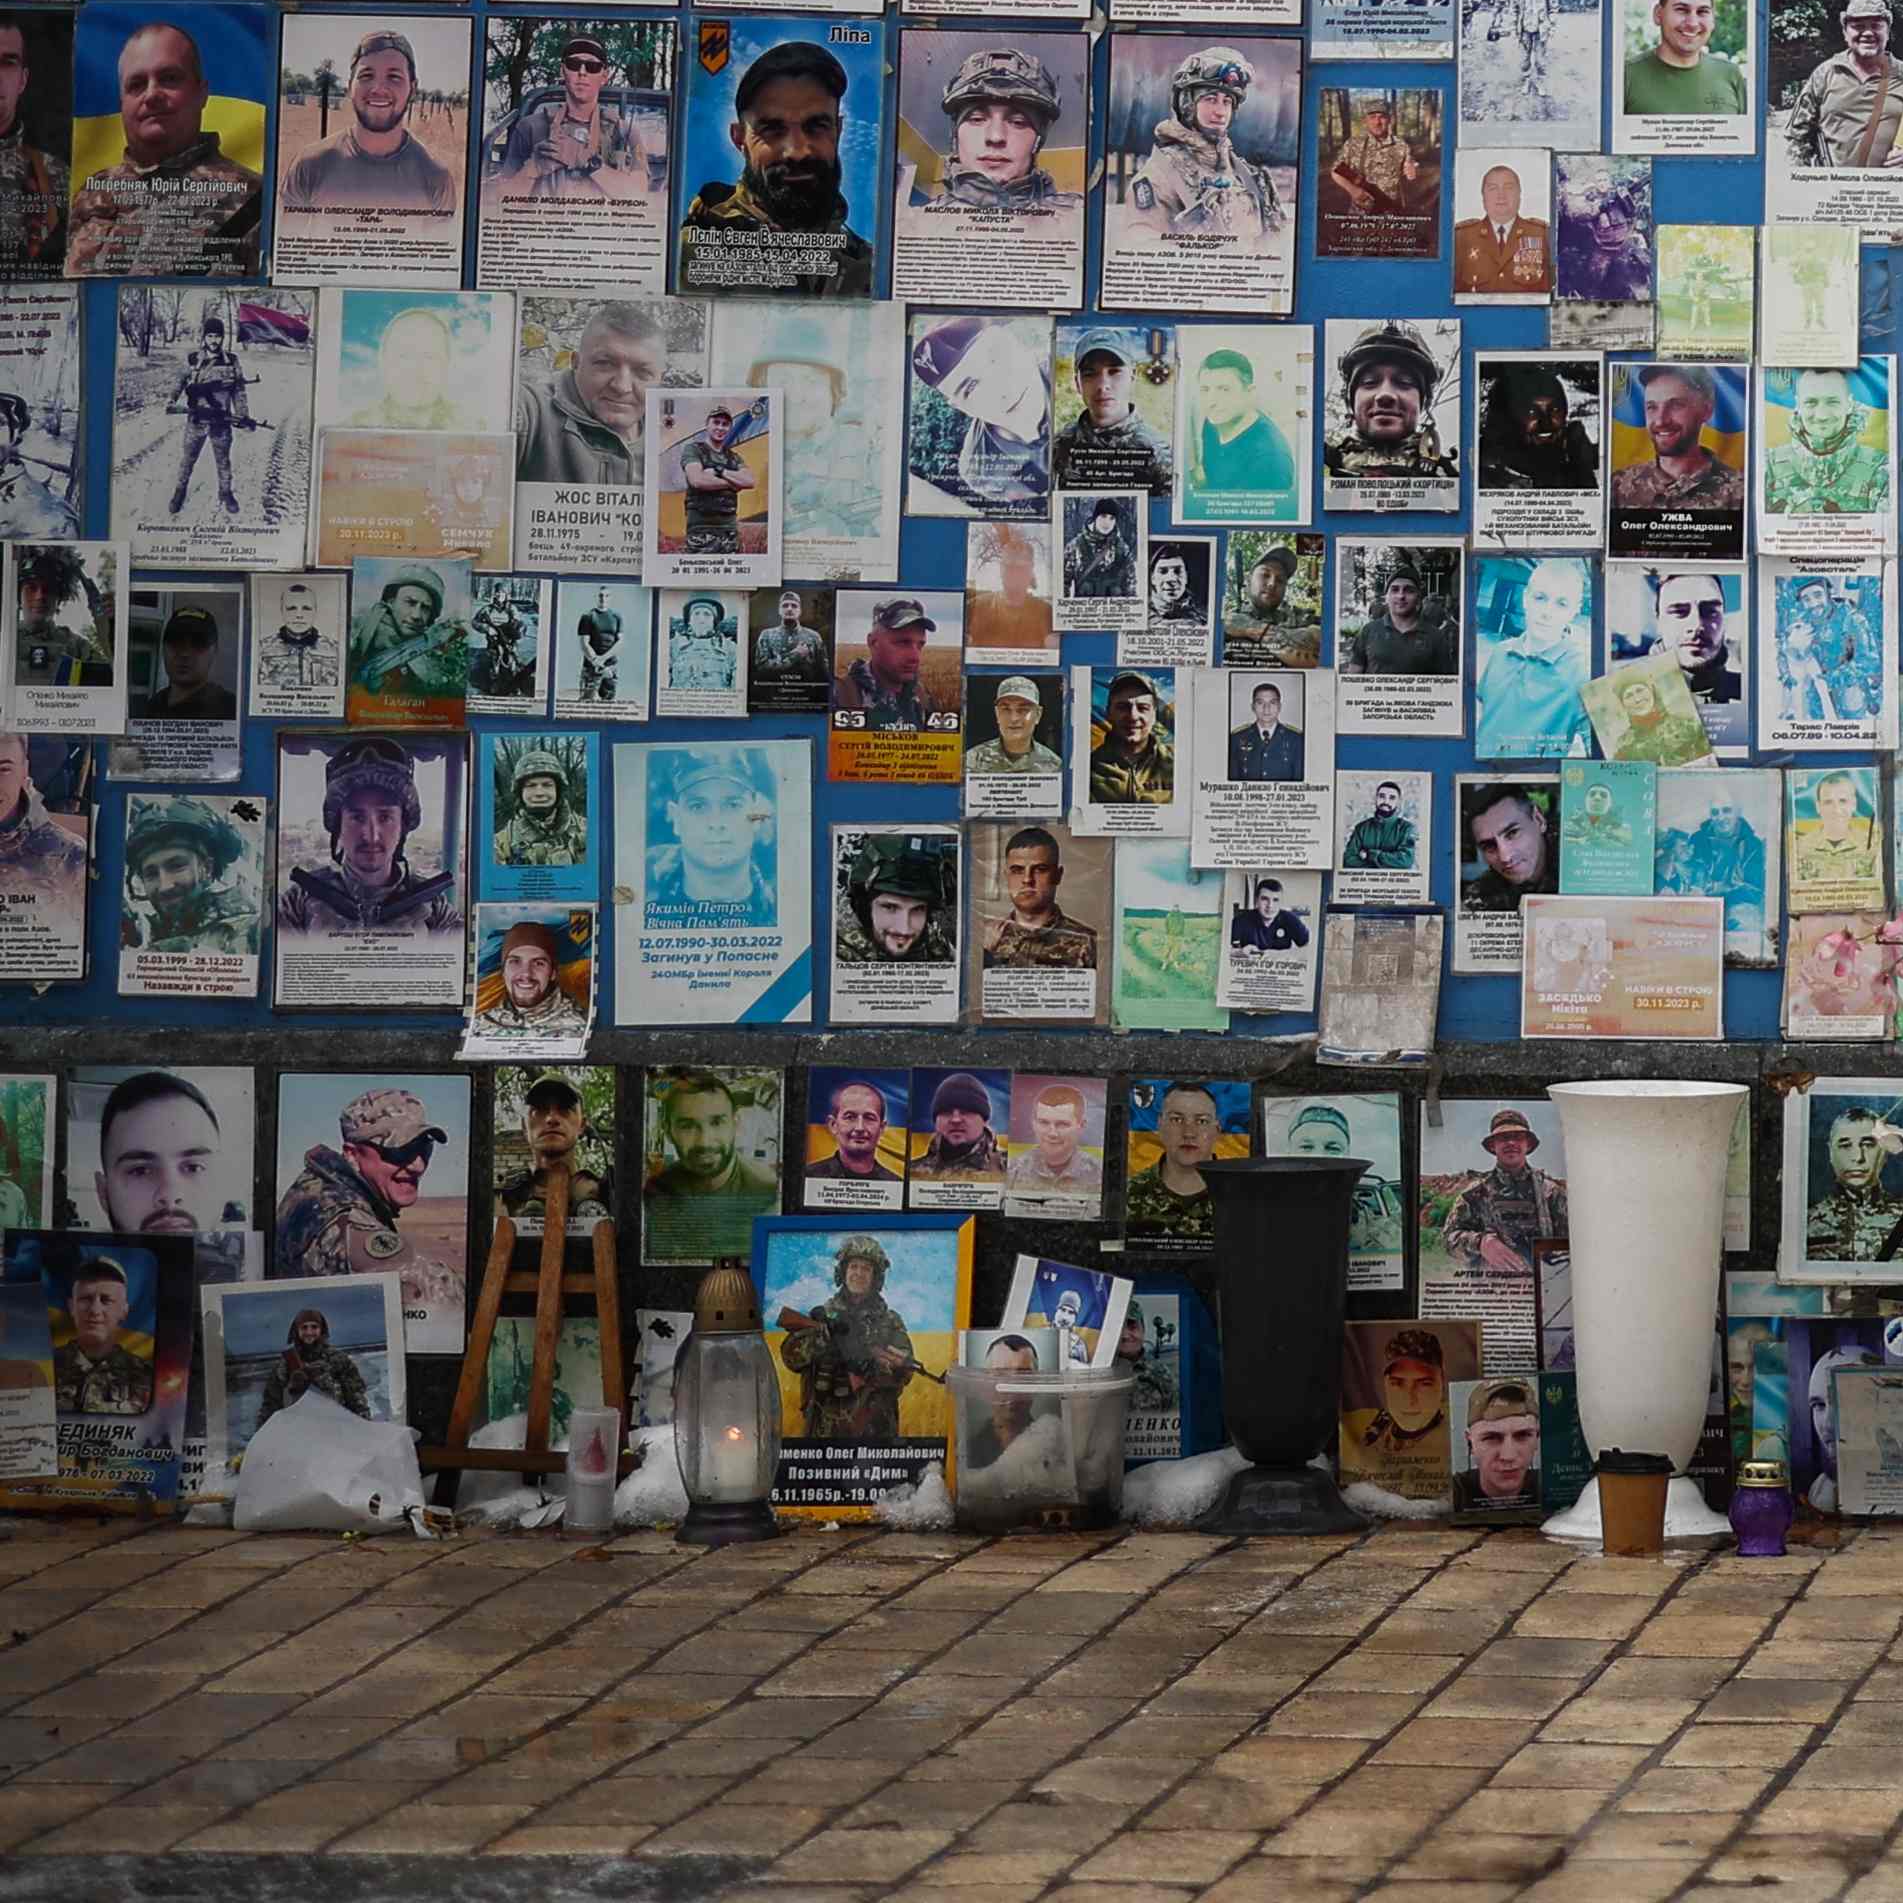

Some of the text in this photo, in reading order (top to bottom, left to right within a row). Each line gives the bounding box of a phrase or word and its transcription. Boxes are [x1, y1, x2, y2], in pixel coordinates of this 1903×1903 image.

[830, 26, 870, 42] Ліпа
[86, 177, 247, 192] Погребняк Юрій Сергійович
[724, 228, 758, 244] Євген
[695, 248, 831, 262] 15.01.1985-15.04.2022
[555, 491, 591, 504] ЖОС
[531, 510, 611, 525] ІВАНОВИЧ
[1662, 513, 1692, 521] УЖВА
[1621, 521, 1732, 531] Олег Олександрович
[698, 902, 745, 914] Петро
[639, 936, 783, 949] 12.07.1990-30.03.2022
[641, 951, 779, 965] Загинув у Попасне
[826, 1447, 944, 1458] Олег Миколайович
[788, 1466, 908, 1480] Позивний «Дим»
